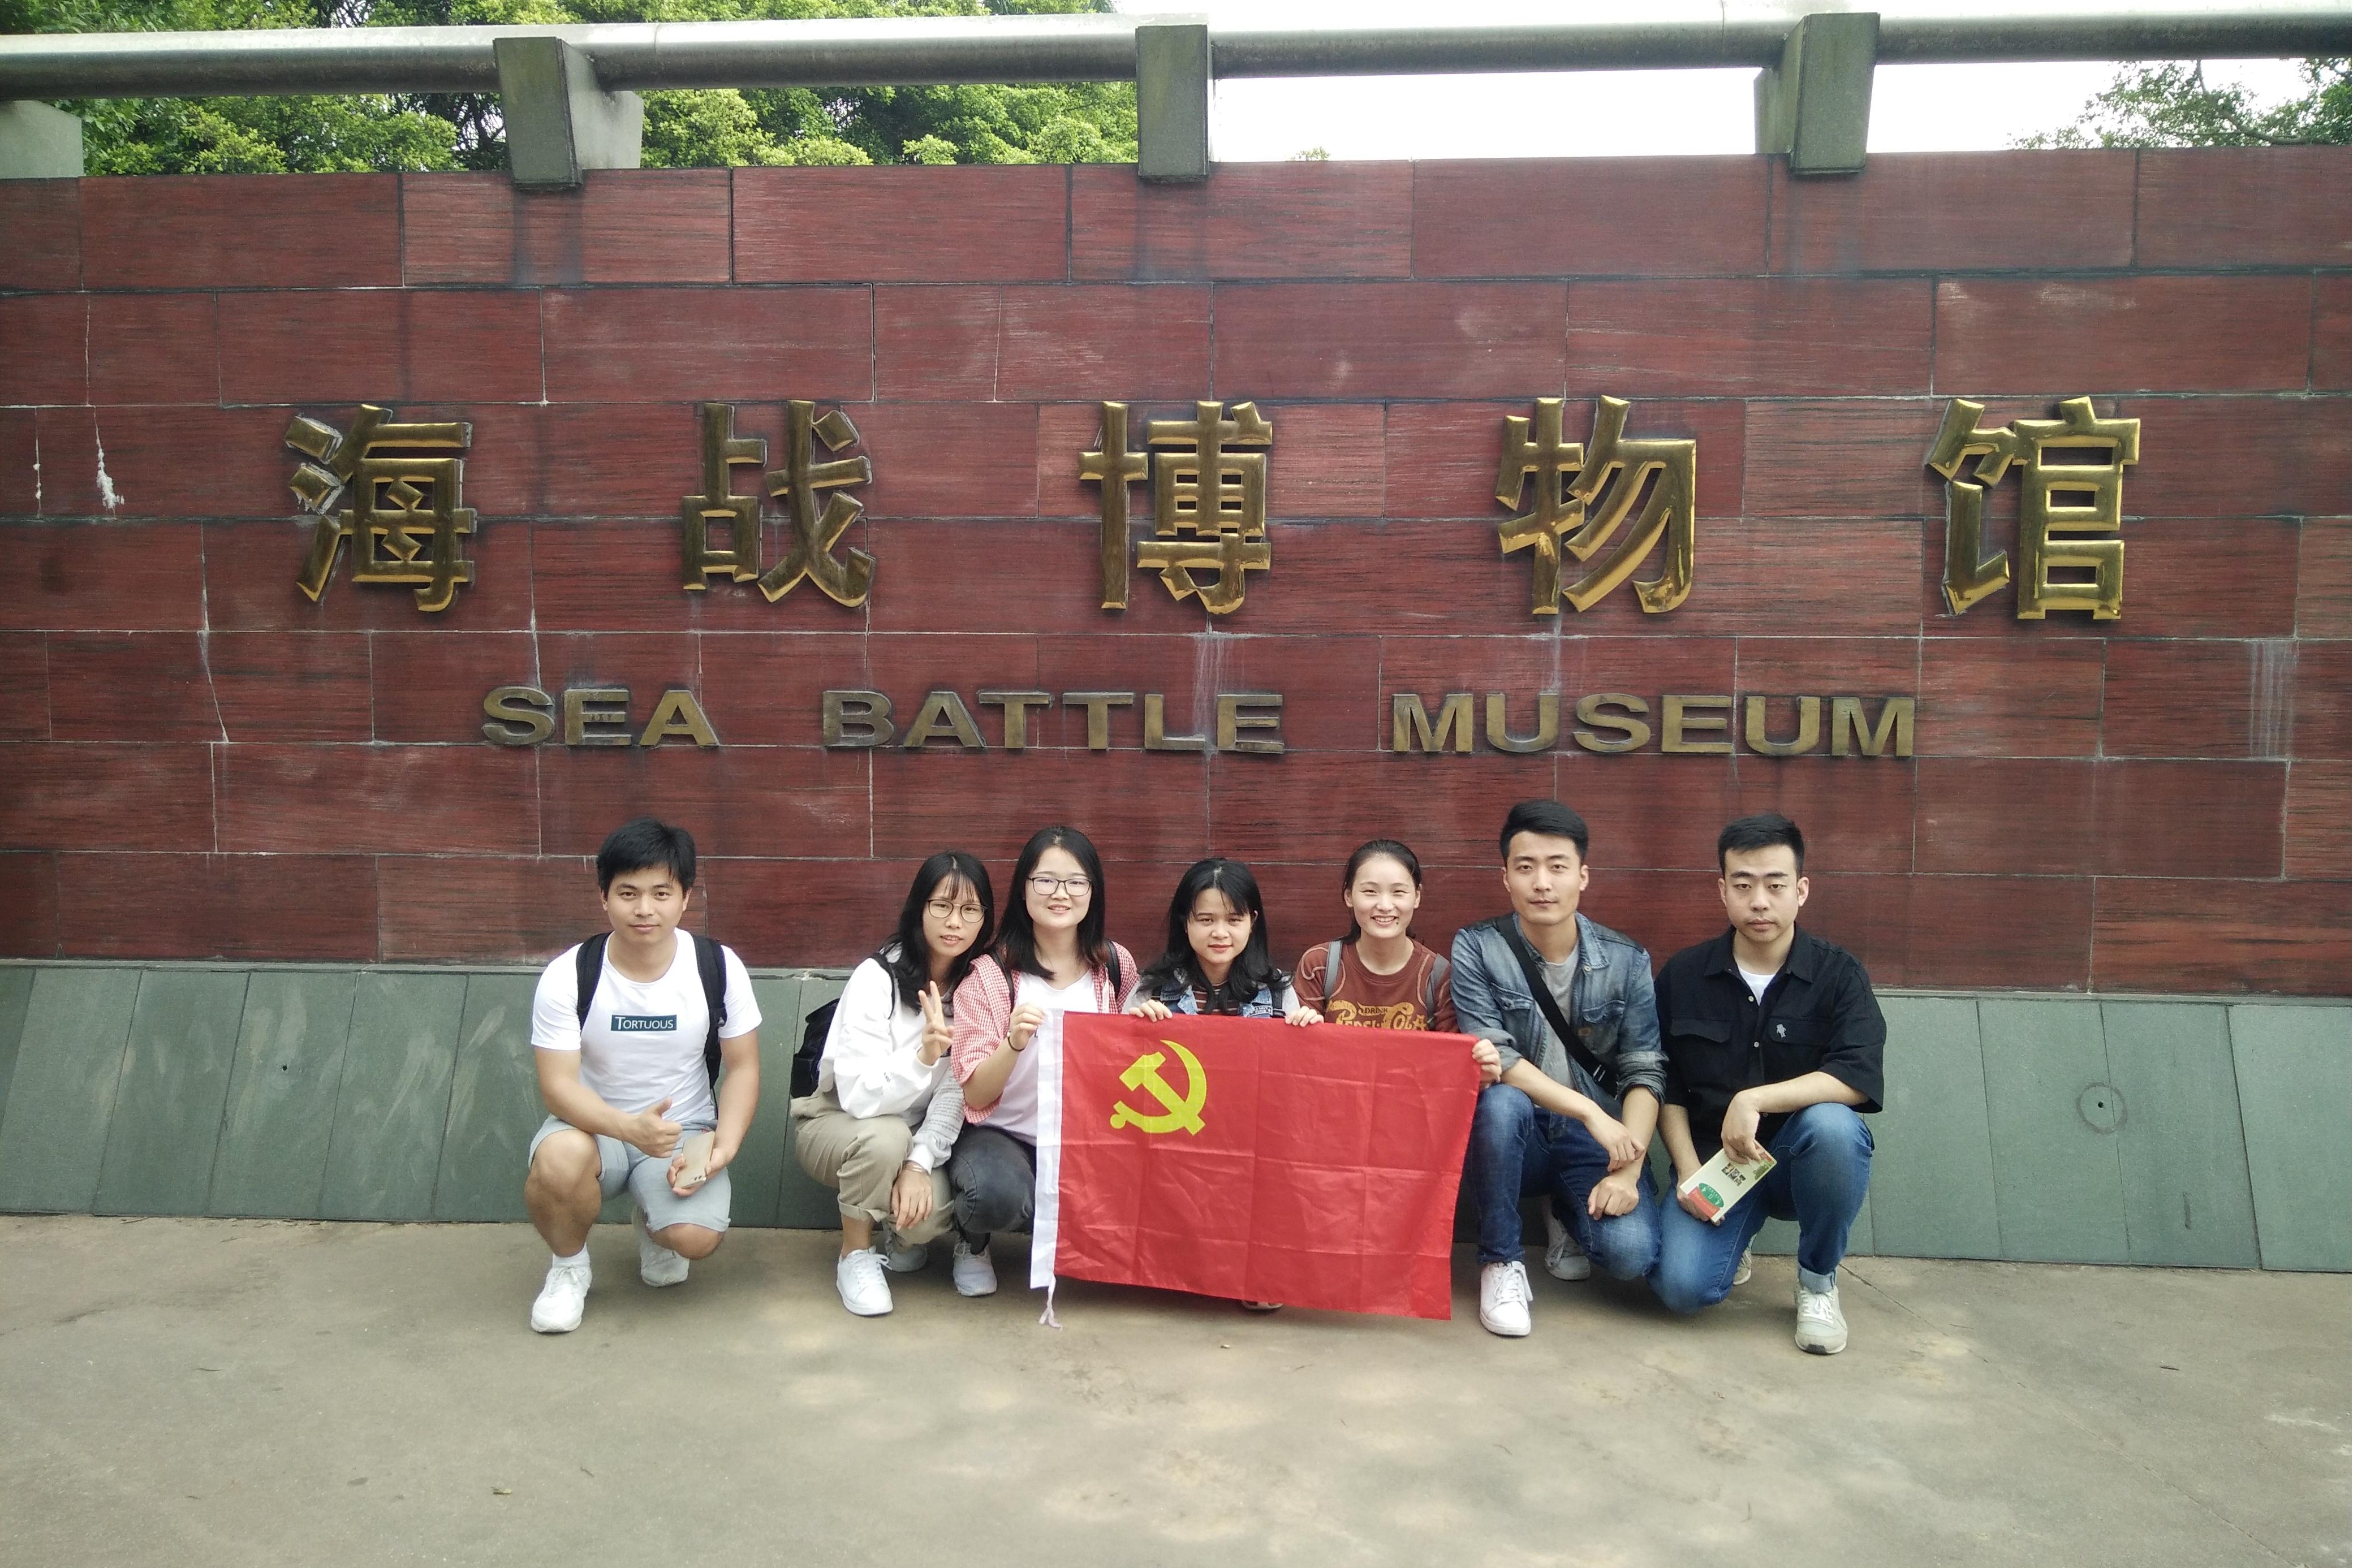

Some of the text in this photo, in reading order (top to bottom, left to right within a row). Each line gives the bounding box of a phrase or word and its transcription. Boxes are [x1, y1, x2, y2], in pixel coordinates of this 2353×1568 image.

[285, 396, 2140, 620] 海战博物馆
[482, 686, 1916, 758] SEA BATTLE MUSEUM
